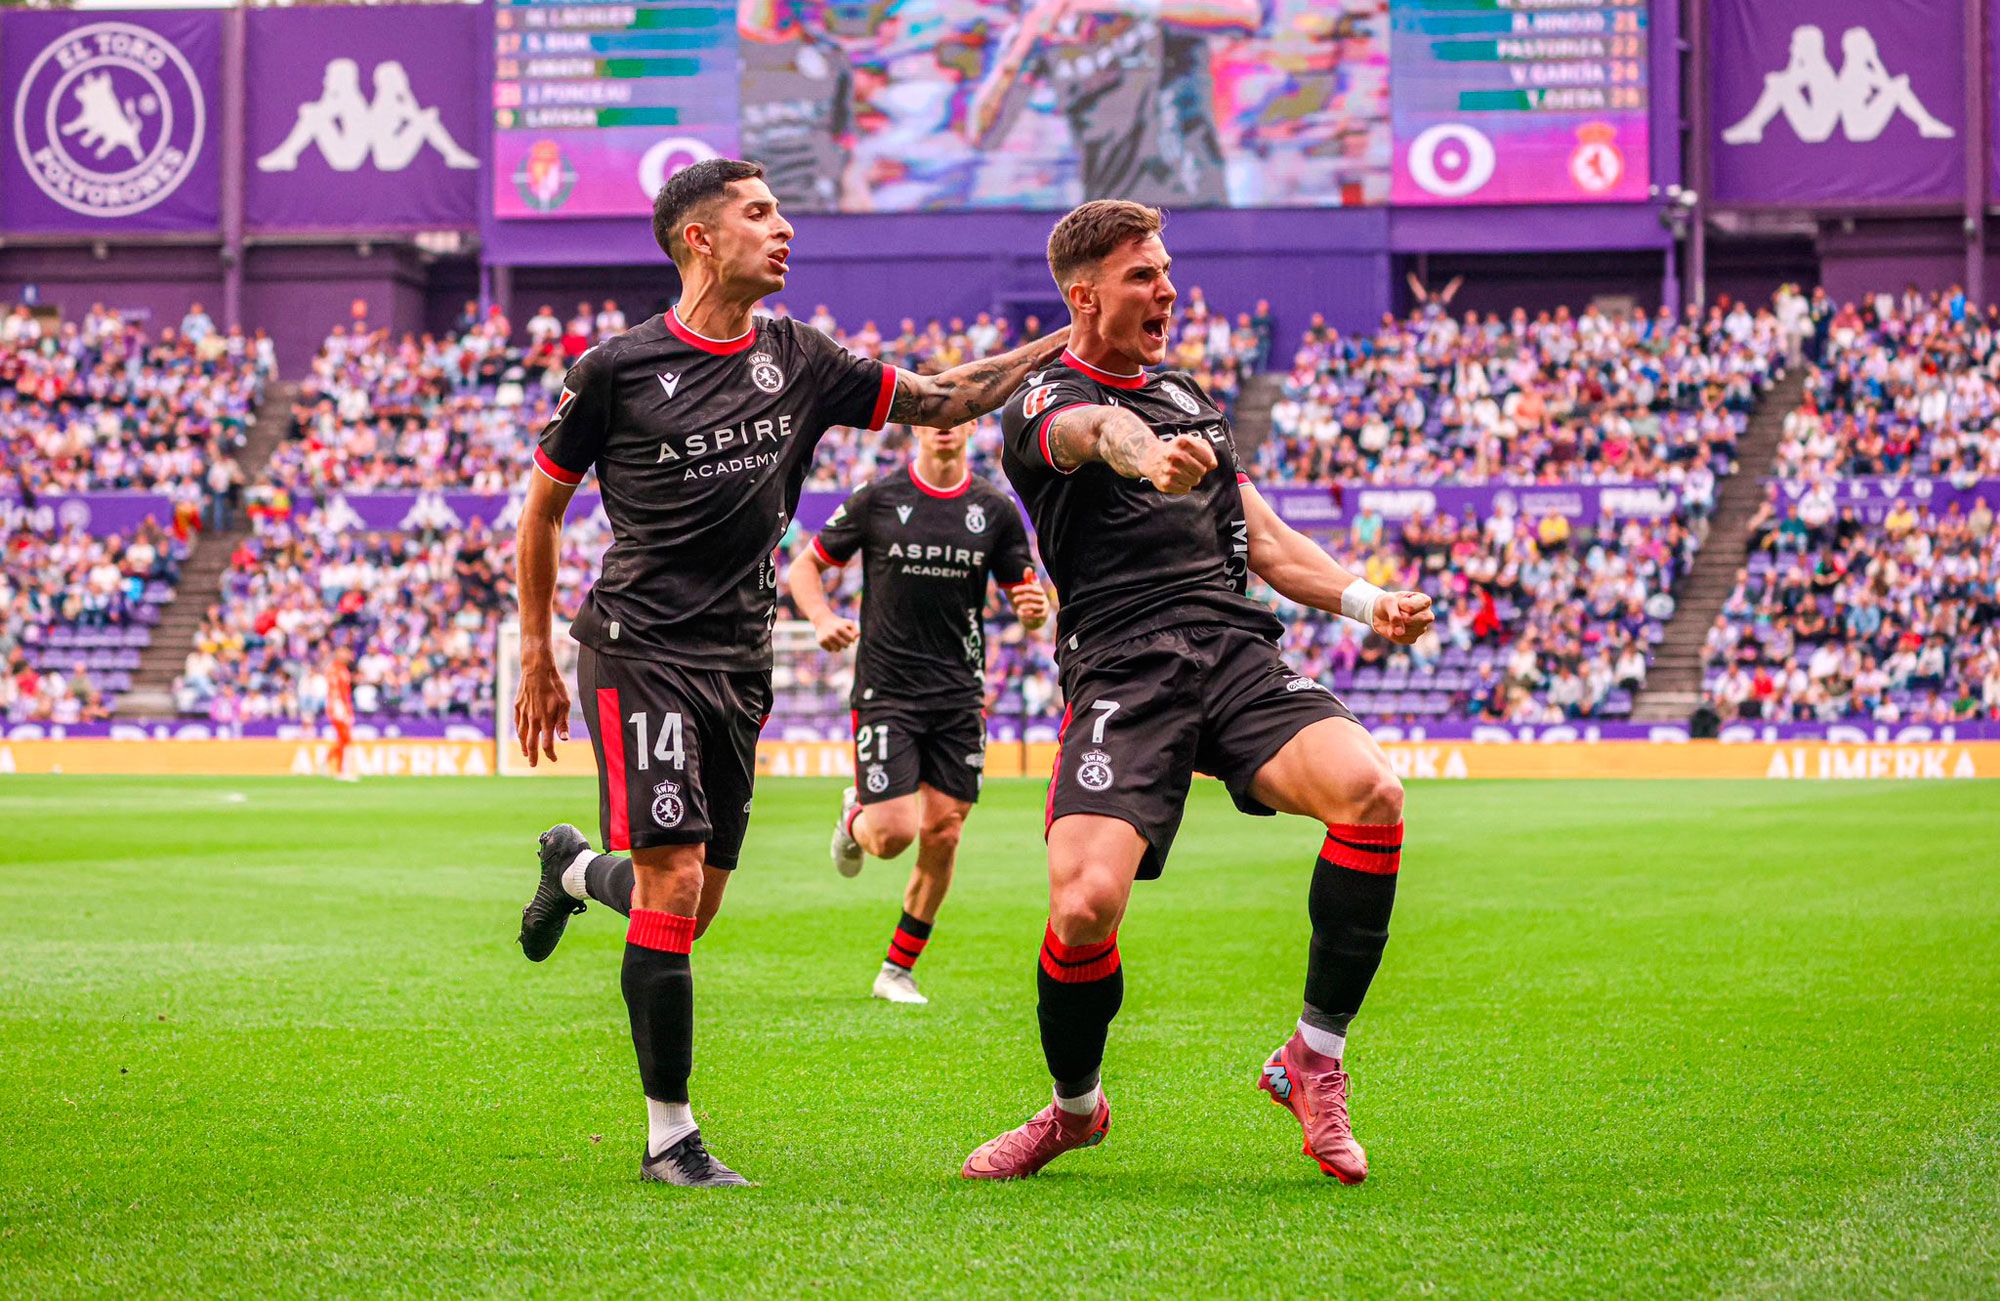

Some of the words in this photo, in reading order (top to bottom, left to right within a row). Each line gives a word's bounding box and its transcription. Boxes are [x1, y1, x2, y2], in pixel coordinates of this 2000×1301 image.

[55, 33, 93, 71] EL
[95, 32, 167, 71] TORO
[33, 145, 187, 206] POLVORONES
[683, 451, 779, 482] ACADEMY
[888, 543, 986, 566] ASPIRE
[901, 564, 970, 579] ACADEMY
[1091, 699, 1121, 744] 7
[628, 712, 686, 771] 14
[857, 724, 889, 762] 21
[1765, 747, 1976, 779] ALIMERKA
